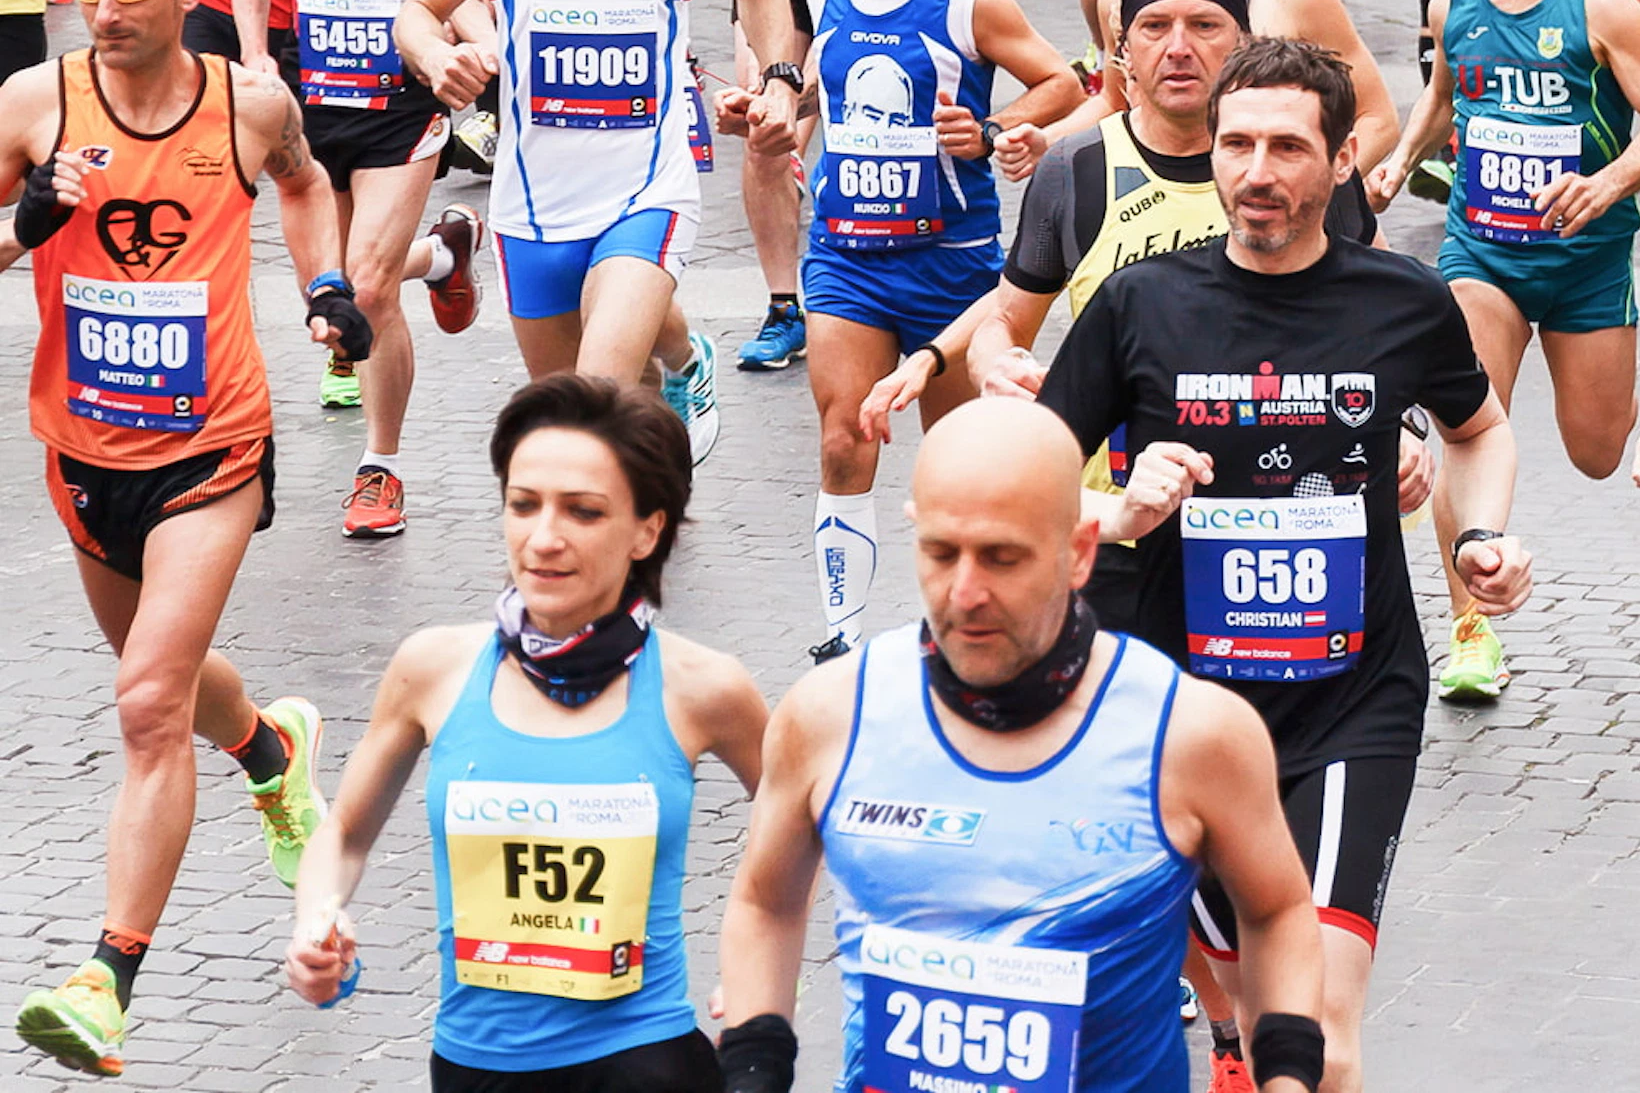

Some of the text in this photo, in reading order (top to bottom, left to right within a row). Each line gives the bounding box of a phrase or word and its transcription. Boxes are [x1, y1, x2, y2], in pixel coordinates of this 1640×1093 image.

[533, 9, 598, 26] acea
[309, 18, 389, 56] 5455
[850, 31, 901, 46] GIVOVA
[538, 46, 649, 87] 11909
[1469, 126, 1525, 147] acea
[838, 158, 922, 199] 6867
[1480, 152, 1563, 195] 8891
[1491, 194, 1532, 210] MICHELE
[66, 282, 136, 308] acea
[78, 316, 190, 370] 6880
[98, 369, 146, 387] MATTEO
[1344, 392, 1366, 407] 10
[1175, 401, 1232, 426] 70.3
[1260, 401, 1326, 415] AUSTRIA
[1187, 506, 1361, 530] acea MARATONA
[1295, 518, 1335, 529] ROMA
[1222, 547, 1328, 604] 658
[1225, 611, 1303, 628] CHRISTIAN
[1203, 637, 1292, 659] NB new balance
[1225, 664, 1296, 680] 1 A
[452, 797, 652, 825] acea MARATONA
[846, 800, 927, 829] TWINS
[502, 842, 606, 905] F52
[510, 912, 575, 931] ANGELA
[530, 955, 572, 969] balance
[866, 939, 1080, 981] acea MARATONA
[884, 989, 1051, 1082] 2659
[908, 1069, 988, 1093] MASSIMO
